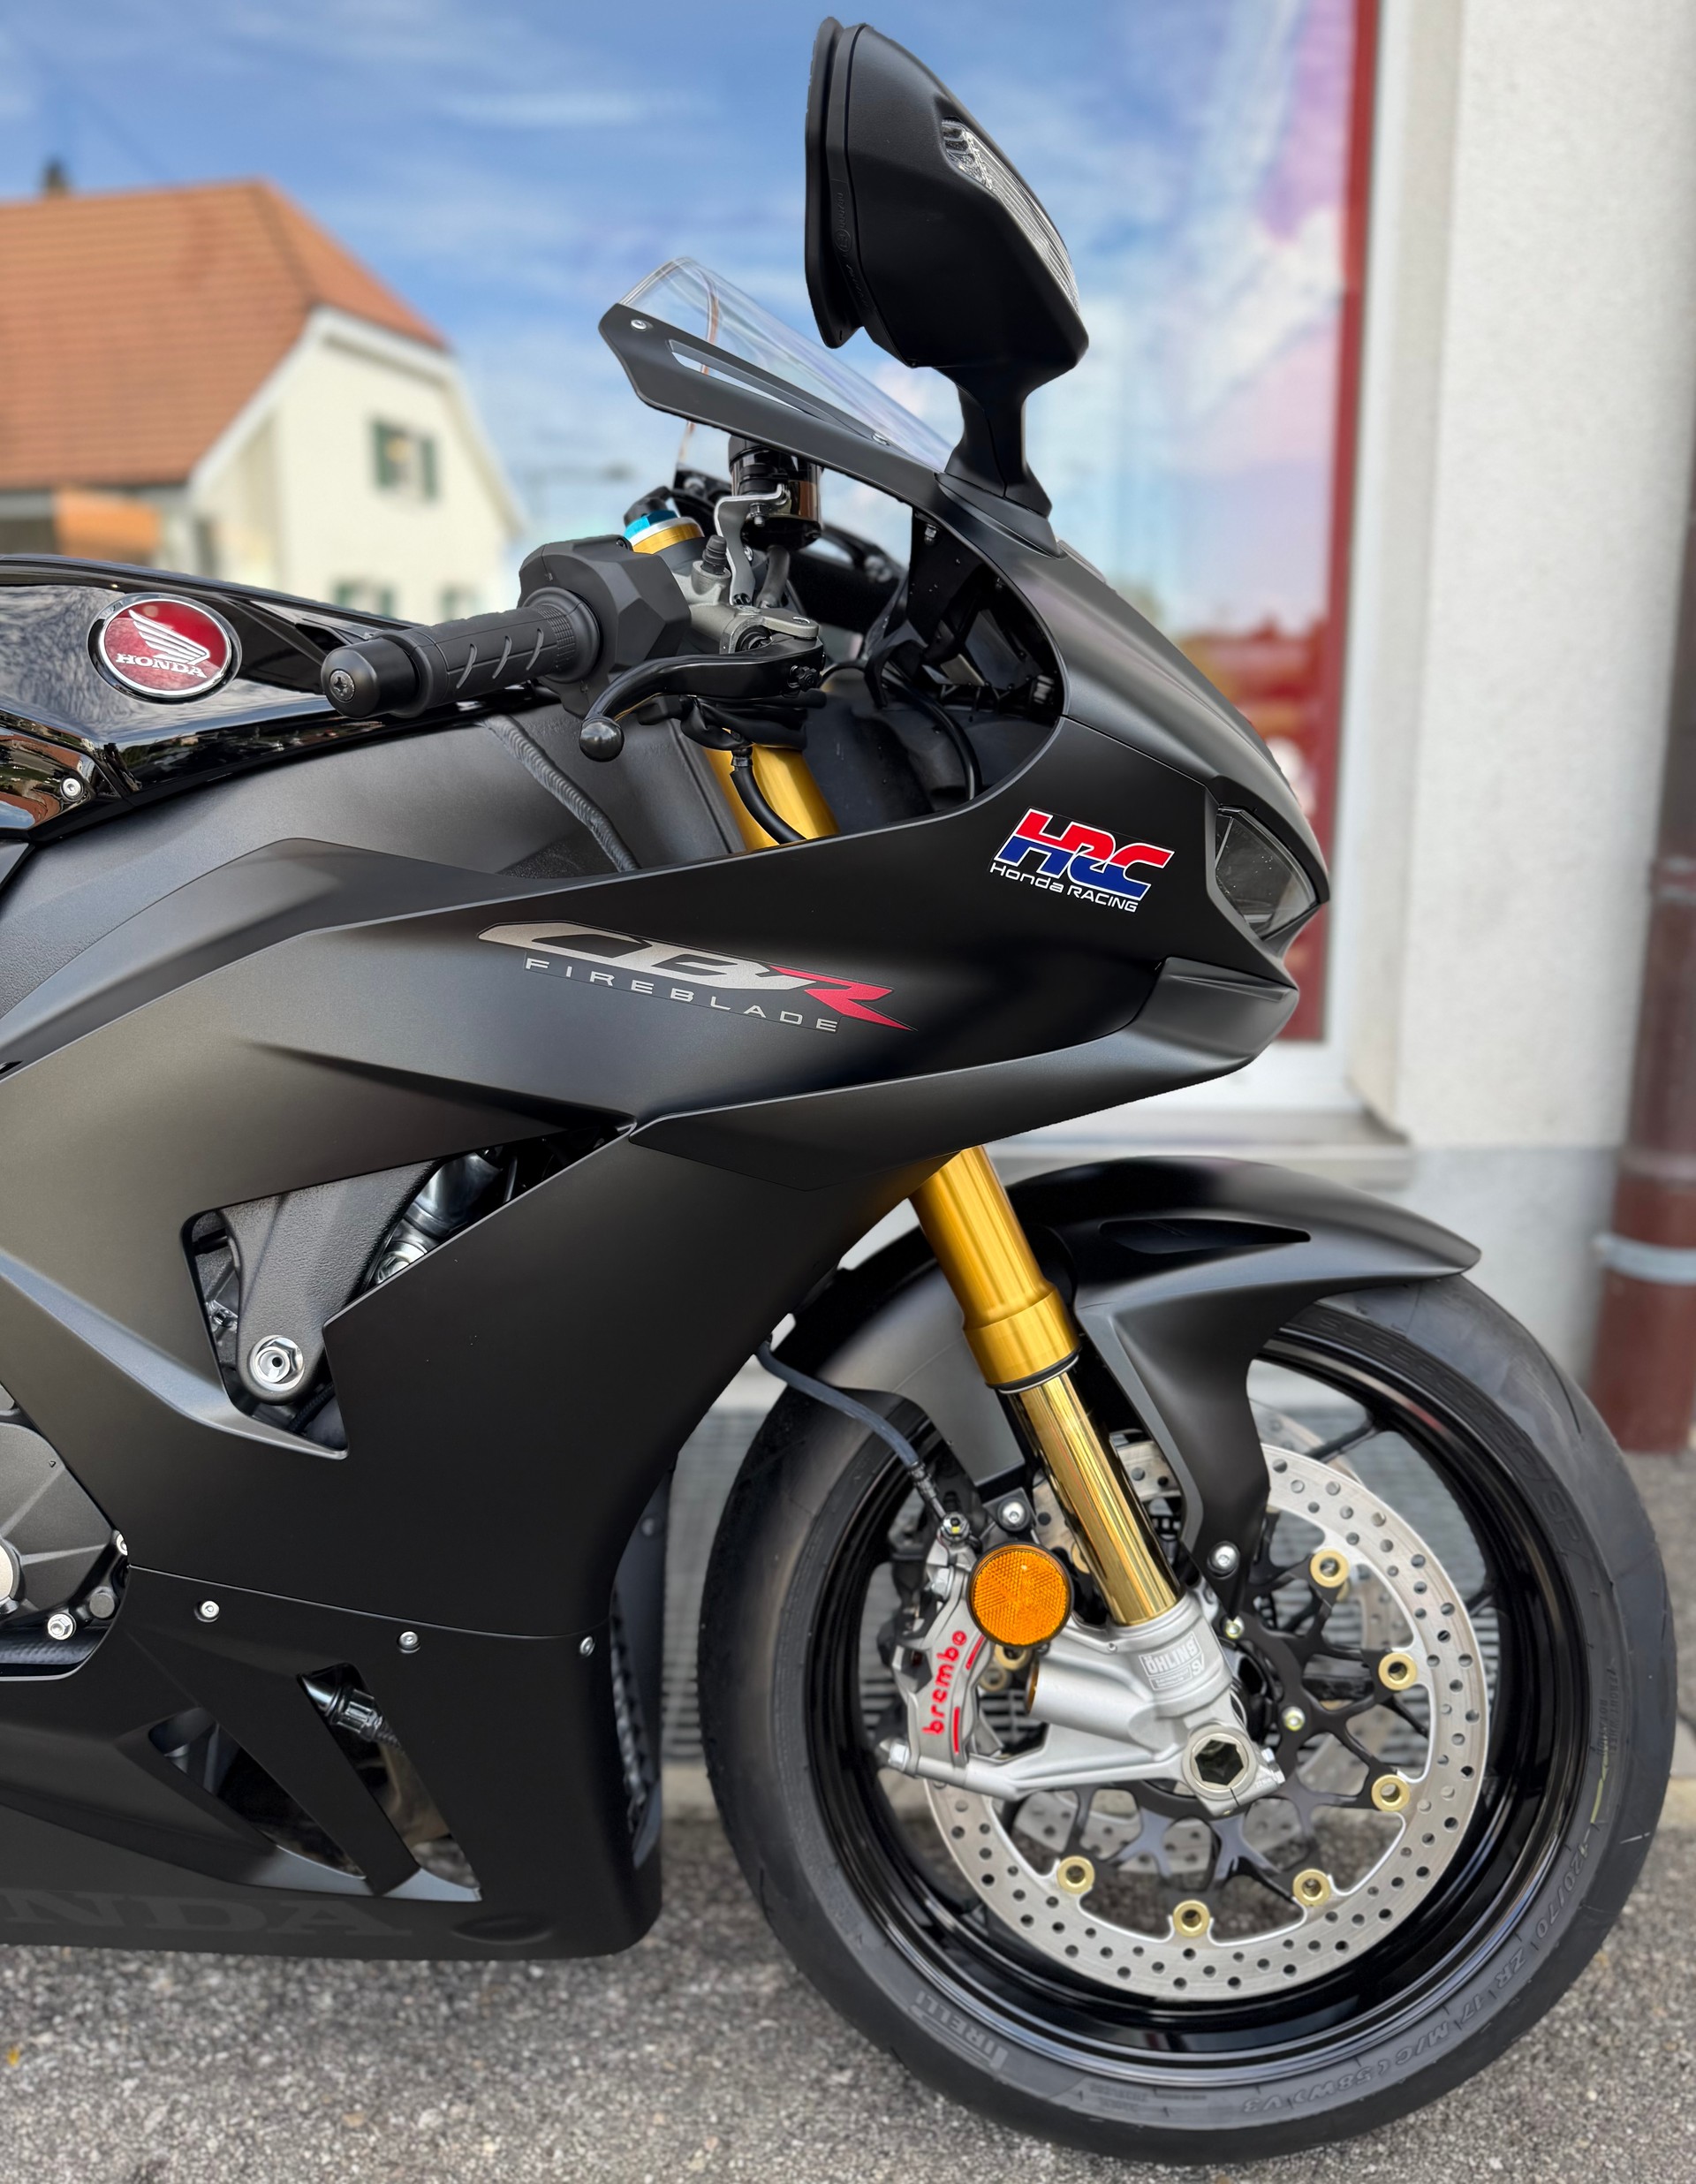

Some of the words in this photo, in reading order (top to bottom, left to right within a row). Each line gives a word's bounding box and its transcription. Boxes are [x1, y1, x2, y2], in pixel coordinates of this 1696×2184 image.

[116, 653, 208, 679] HONDA
[994, 808, 1175, 901] HRC
[989, 862, 1063, 893] Honda
[1066, 884, 1139, 913] RACING
[478, 921, 914, 1032] CBR
[525, 957, 837, 1033] FIREBLADE
[922, 1631, 967, 1736] brembo
[1143, 1638, 1199, 1674] ÖHLINS
[1535, 1839, 1589, 1939] 120/70
[1498, 1948, 1526, 1989] ZR
[908, 1990, 1009, 2069] PIRELLI
[1461, 1994, 1486, 2022] 17
[1397, 2021, 1450, 2066] M/C
